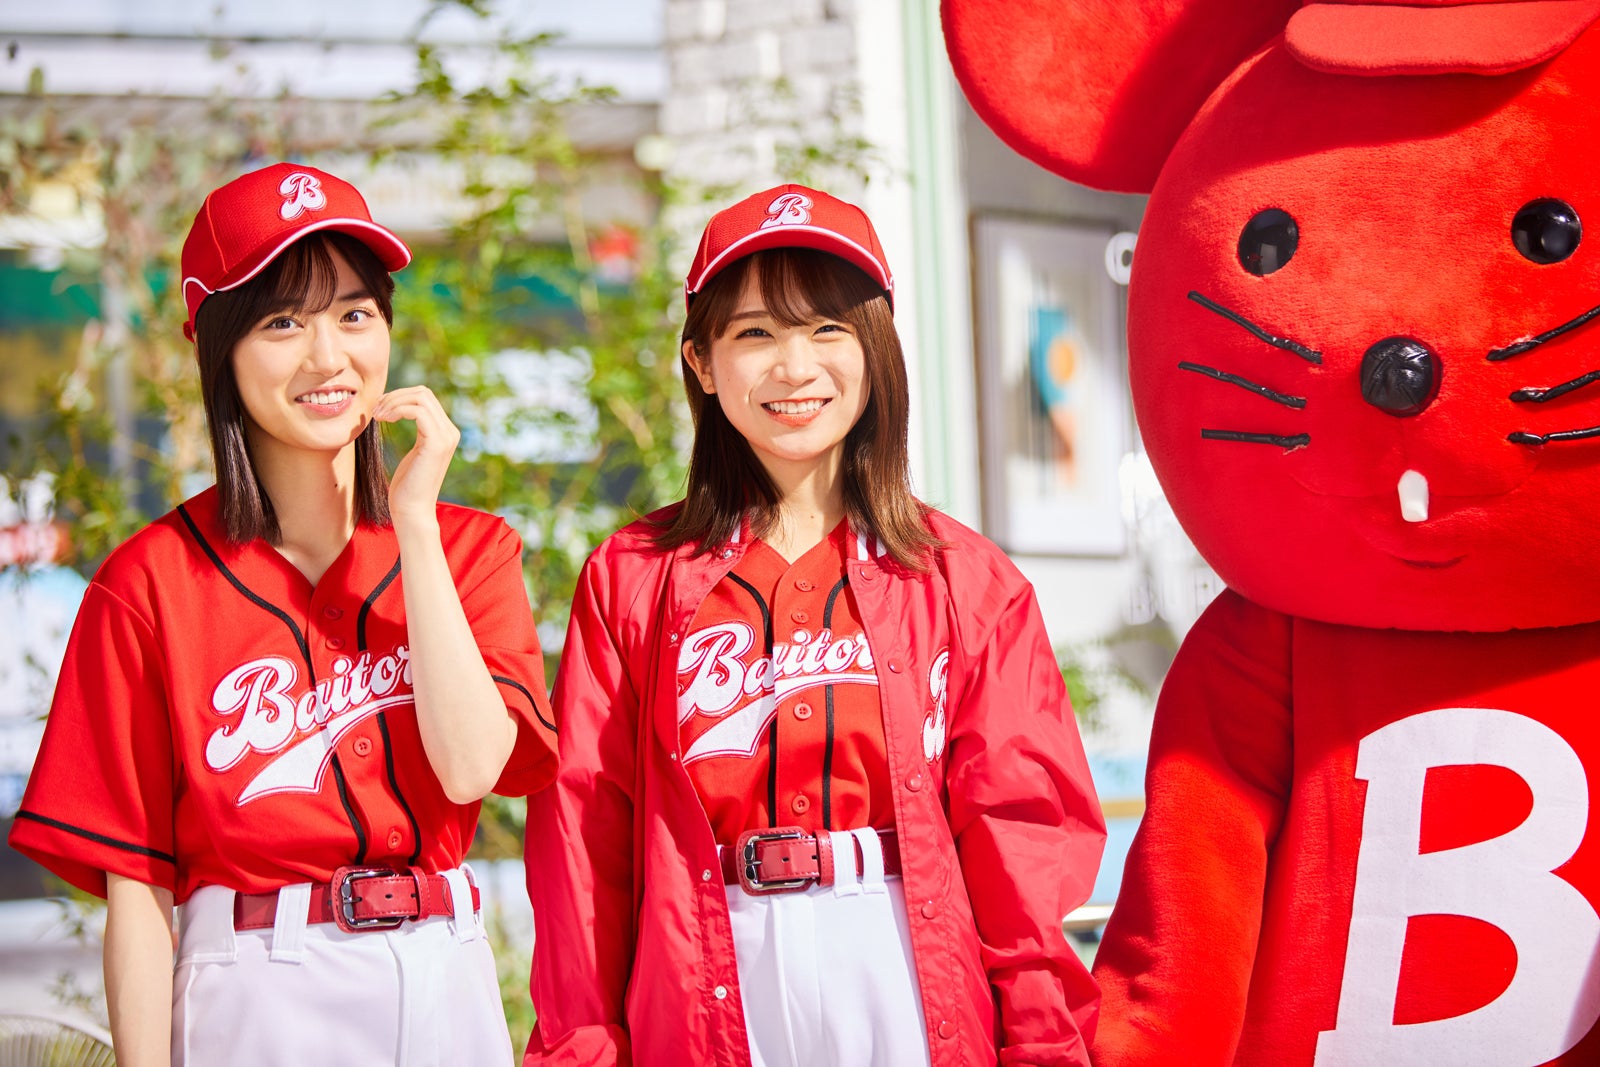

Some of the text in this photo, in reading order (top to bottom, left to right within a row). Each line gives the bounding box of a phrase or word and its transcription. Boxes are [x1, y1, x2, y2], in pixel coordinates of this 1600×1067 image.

[277, 171, 327, 221] B
[757, 192, 813, 231] B
[1316, 707, 1600, 1067] B
